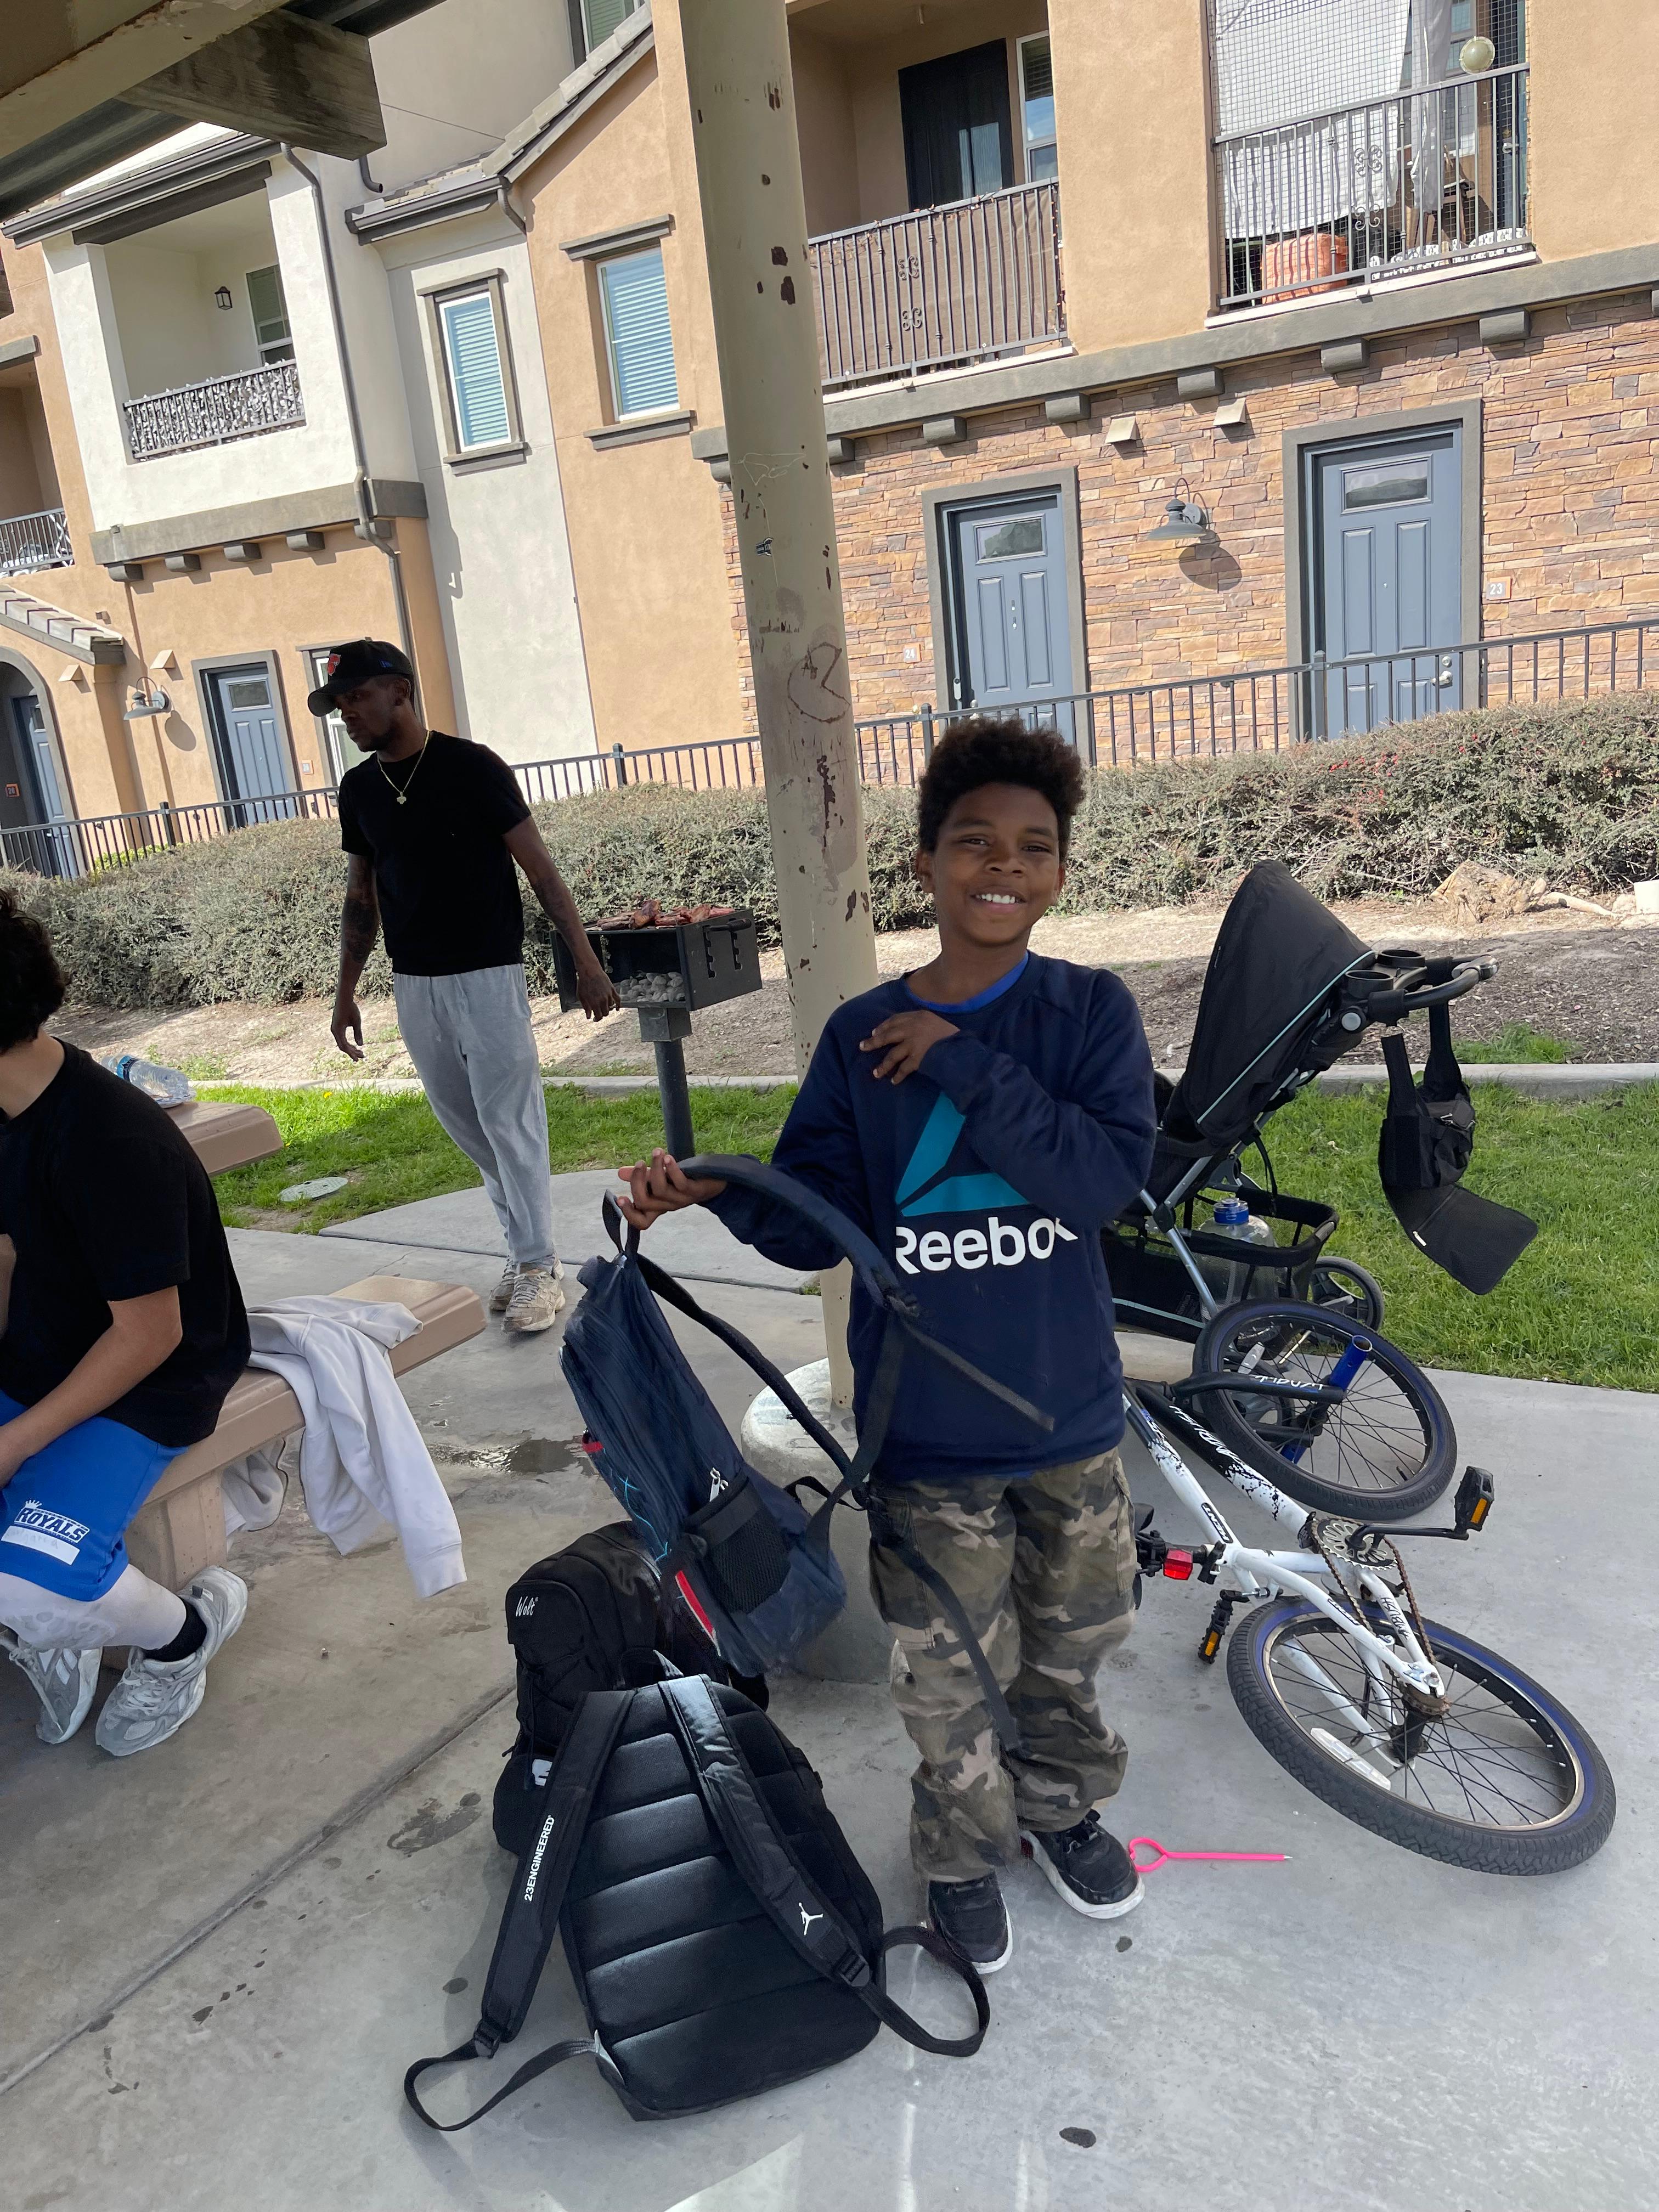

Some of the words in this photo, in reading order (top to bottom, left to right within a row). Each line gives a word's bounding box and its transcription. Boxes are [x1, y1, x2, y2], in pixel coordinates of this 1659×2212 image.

[1489, 583, 1502, 595] 23
[905, 648, 915, 659] 24
[15, 1507, 87, 1542] ROYALS
[1202, 1505, 1230, 1541] KENT
[1380, 1597, 1410, 1640] AMBUSH
